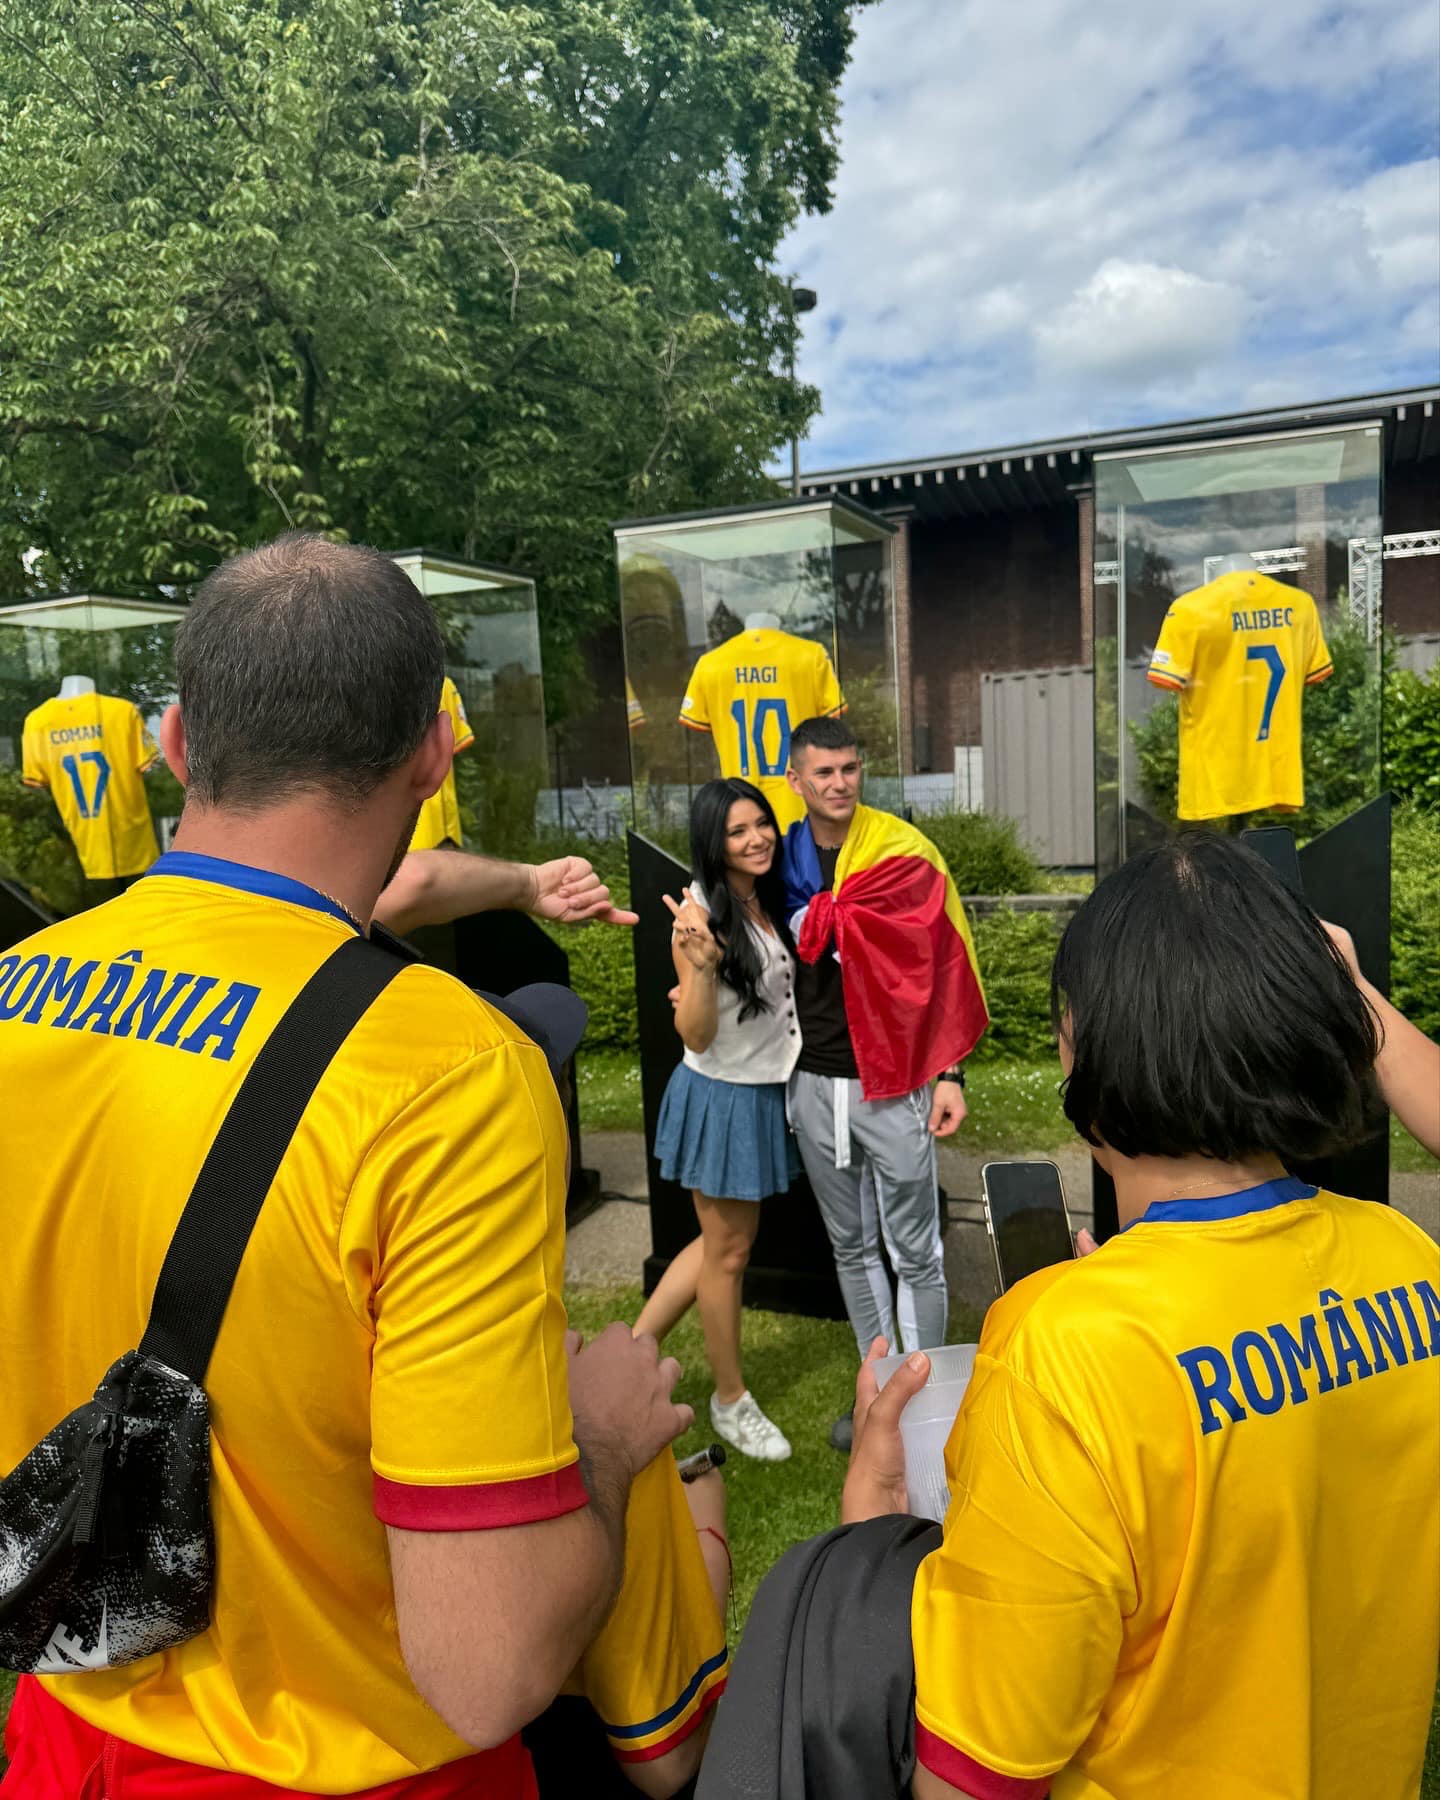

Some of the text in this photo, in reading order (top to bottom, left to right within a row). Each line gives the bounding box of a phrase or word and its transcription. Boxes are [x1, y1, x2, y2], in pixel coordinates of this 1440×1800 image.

[1232, 607, 1293, 632] ALIBEC
[735, 666, 777, 684] HAGI
[1247, 644, 1286, 742] 7
[50, 724, 103, 745] COMAN
[731, 698, 791, 776] 10
[62, 751, 111, 819] 17
